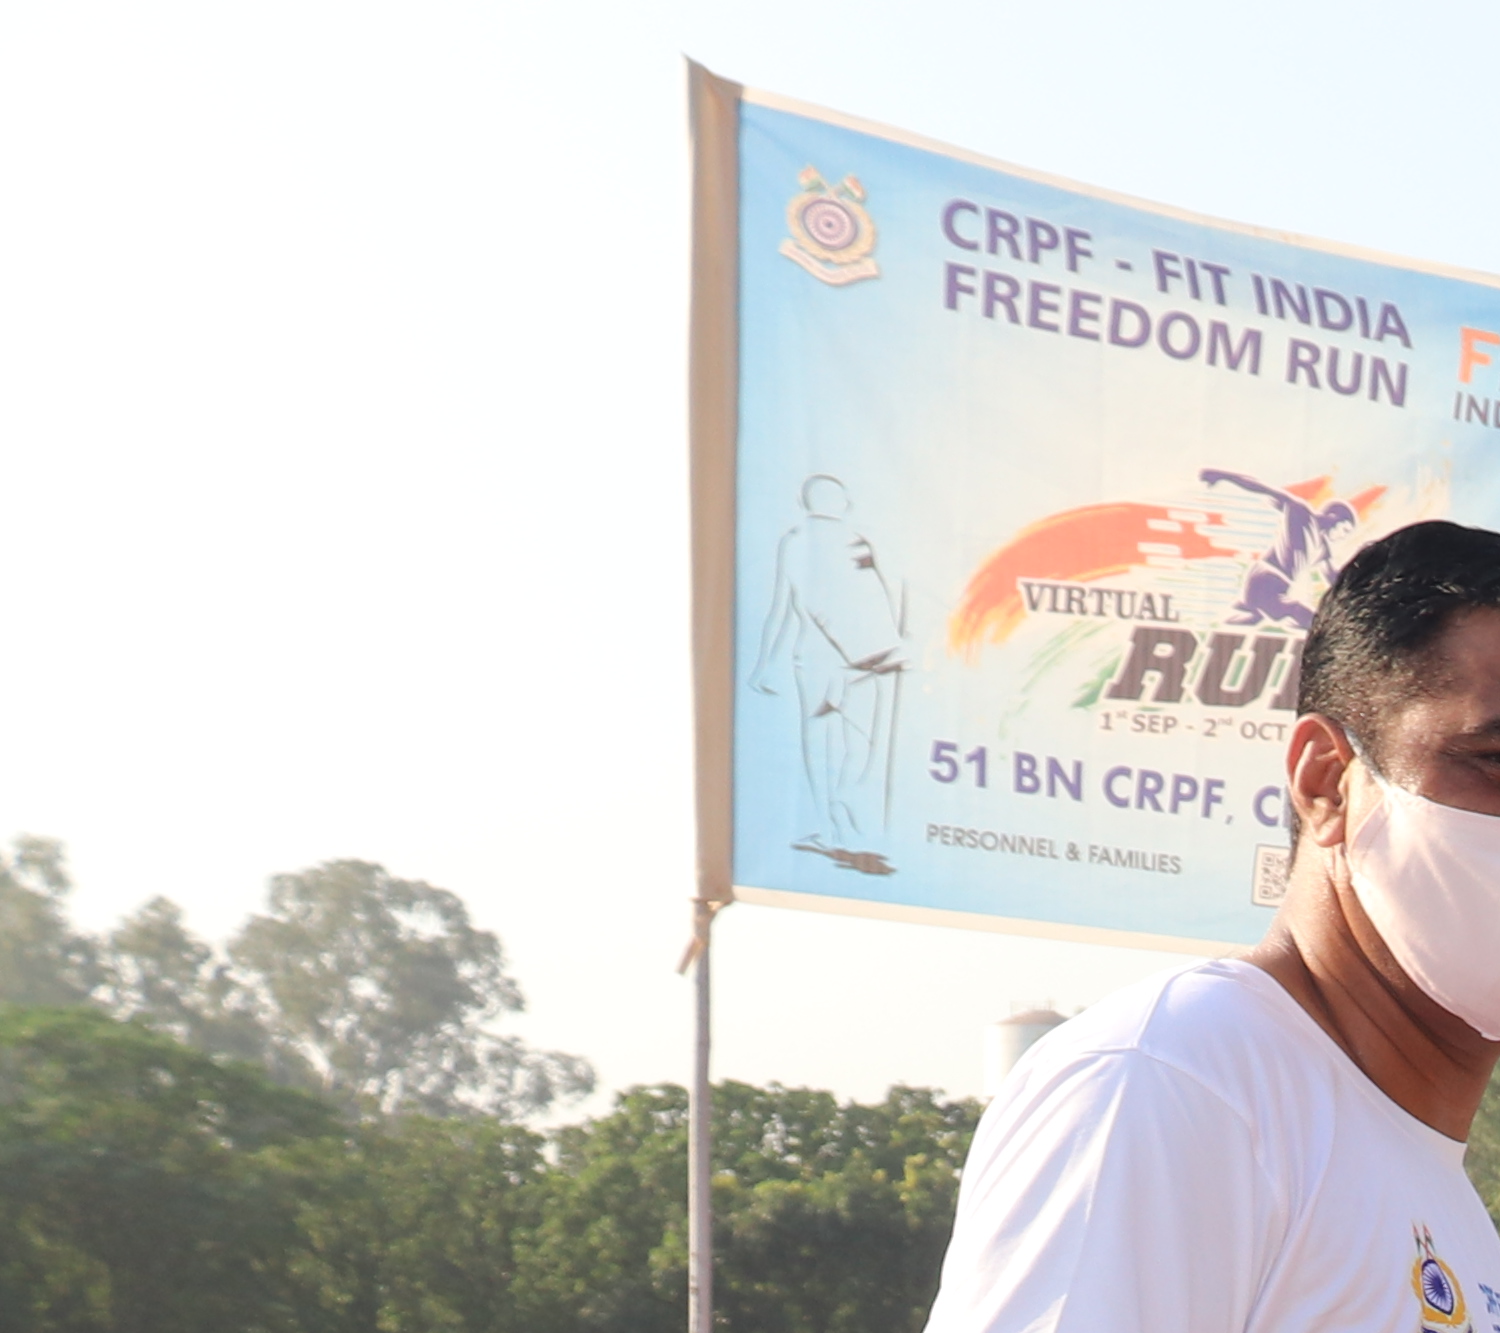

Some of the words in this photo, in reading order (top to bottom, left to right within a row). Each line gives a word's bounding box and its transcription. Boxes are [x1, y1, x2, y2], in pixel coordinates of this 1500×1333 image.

[940, 198, 1094, 273] CRPF
[1152, 248, 1232, 306] FIT
[1251, 273, 1413, 349] INDIA
[943, 260, 1263, 376] FREEDOM
[1285, 337, 1409, 408] RUN
[1020, 582, 1180, 622] VIRTUAL
[1100, 710, 1128, 731] 1st
[1131, 713, 1178, 735] SEP
[1203, 716, 1233, 738] 2nd
[1240, 721, 1288, 742] OCT
[929, 740, 987, 788] 51
[1013, 750, 1083, 801] BN
[1102, 765, 1233, 825] CRPF,
[926, 823, 1058, 860] PERSONNEL
[1065, 842, 1081, 862] &
[1088, 844, 1182, 874] FAMILIES
